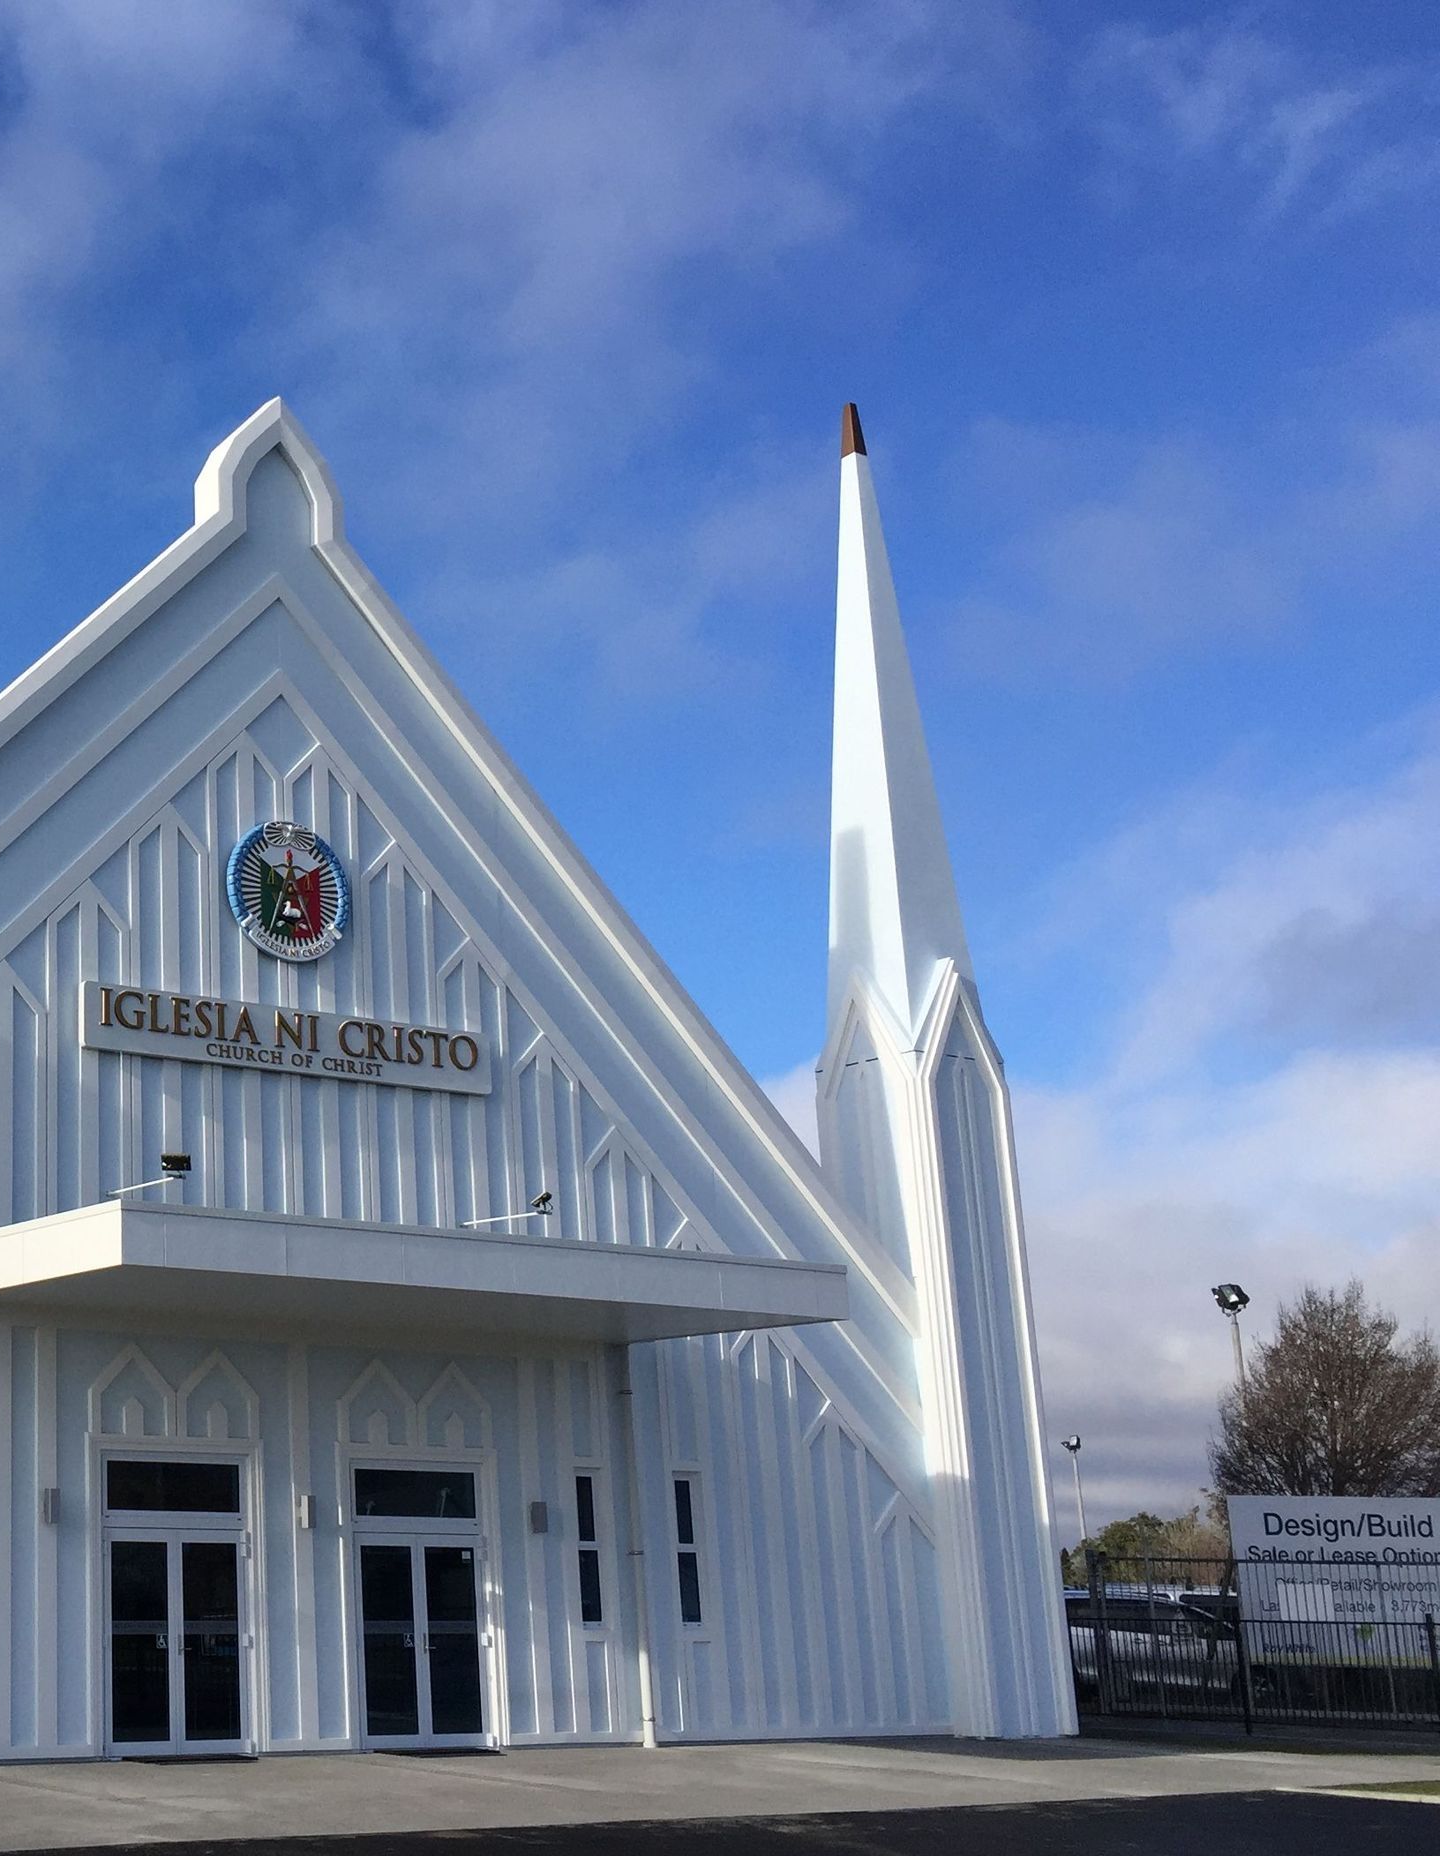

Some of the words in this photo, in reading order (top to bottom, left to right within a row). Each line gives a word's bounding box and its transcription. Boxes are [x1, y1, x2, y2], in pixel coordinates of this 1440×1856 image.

[256, 931, 288, 956] IGLESIA
[289, 948, 300, 958] NI
[302, 940, 330, 958] CRISTO
[99, 987, 262, 1045] IGLESIA
[274, 1009, 320, 1052] NI
[338, 1020, 479, 1071] CRISTO
[206, 1043, 284, 1065] CHURCH
[291, 1053, 313, 1068] OF
[322, 1057, 383, 1077] CHRIST
[1263, 1512, 1434, 1543] Design/Build
[1248, 1545, 1289, 1562] Sale
[1295, 1549, 1314, 1562] or
[1320, 1547, 1377, 1563] Lease
